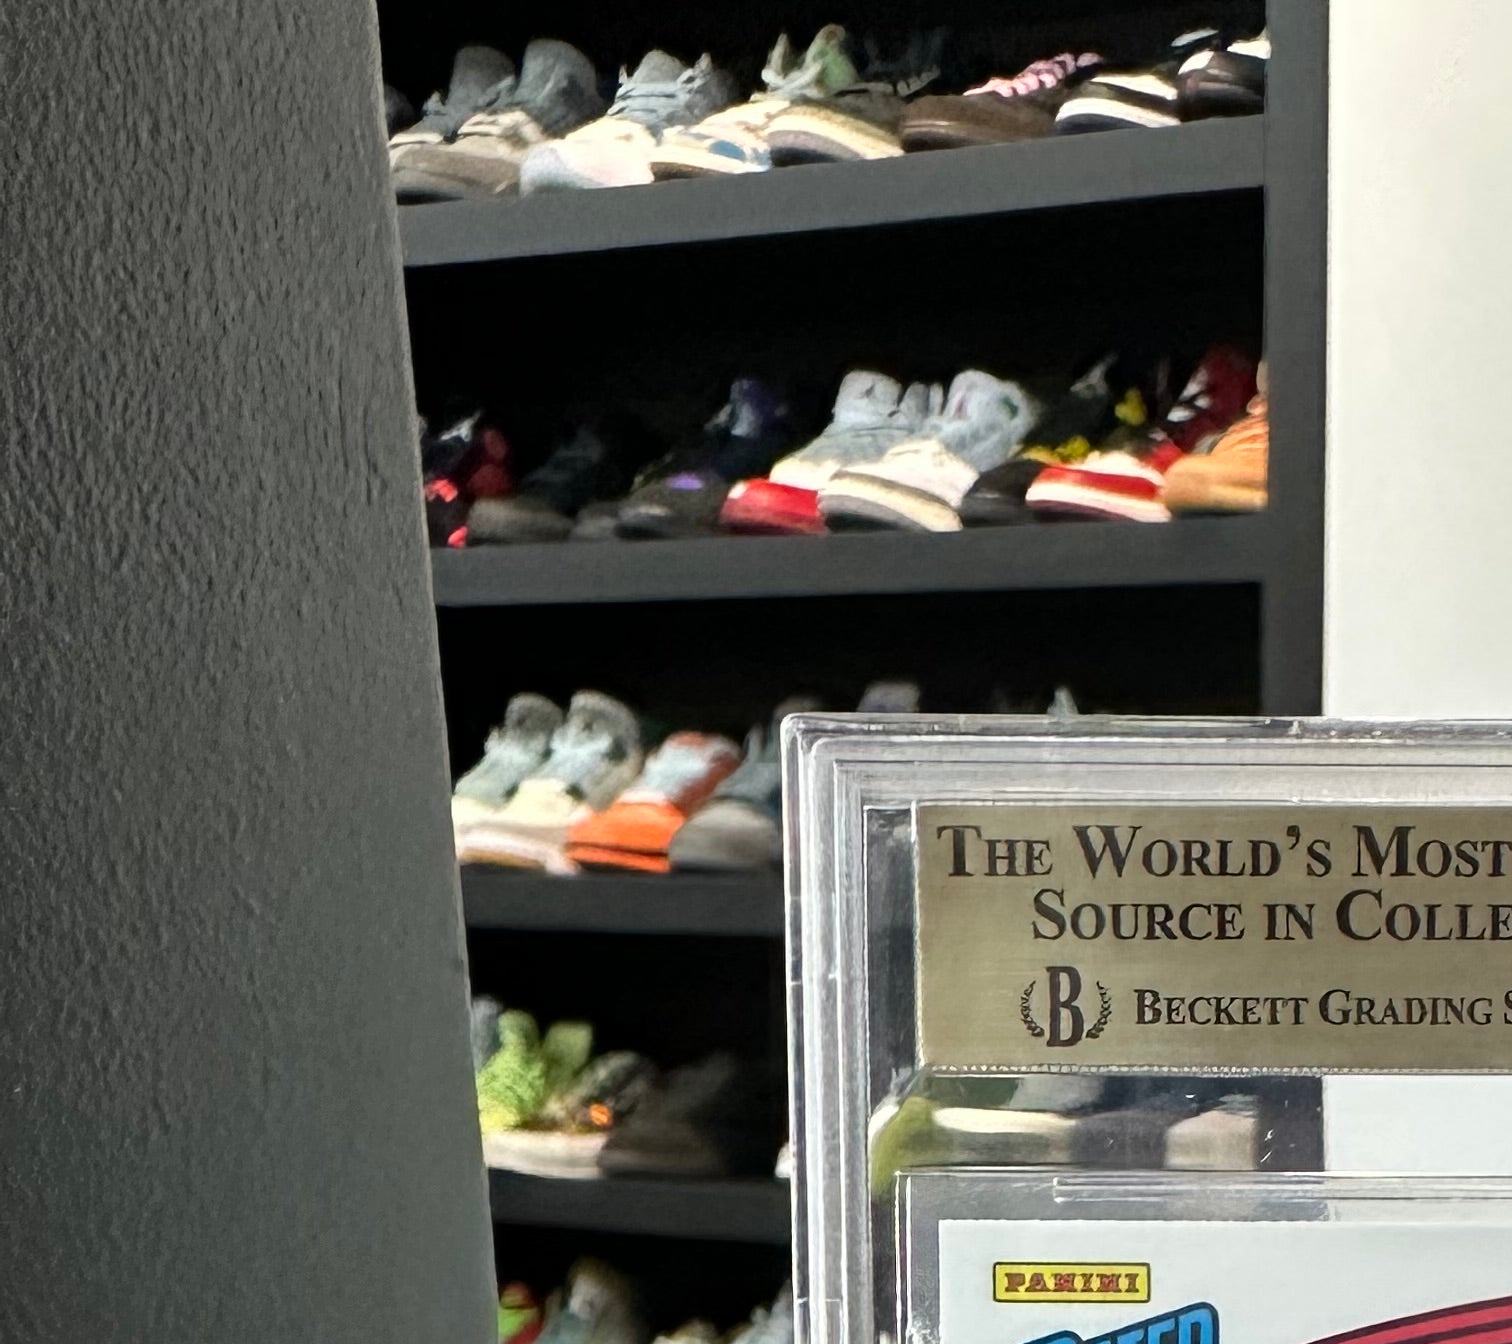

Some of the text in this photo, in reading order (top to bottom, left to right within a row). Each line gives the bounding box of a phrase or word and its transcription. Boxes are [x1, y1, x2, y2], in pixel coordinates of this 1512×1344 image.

[935, 824, 1054, 878] THE
[1071, 823, 1333, 880] WORLD'S
[1030, 887, 1247, 942] SOURCE
[1261, 902, 1317, 942] IN
[1044, 964, 1086, 1049] B
[1132, 987, 1311, 1027] BECKETT
[1317, 987, 1494, 1027] GRADING
[1004, 1272, 1140, 1294] PANINI
